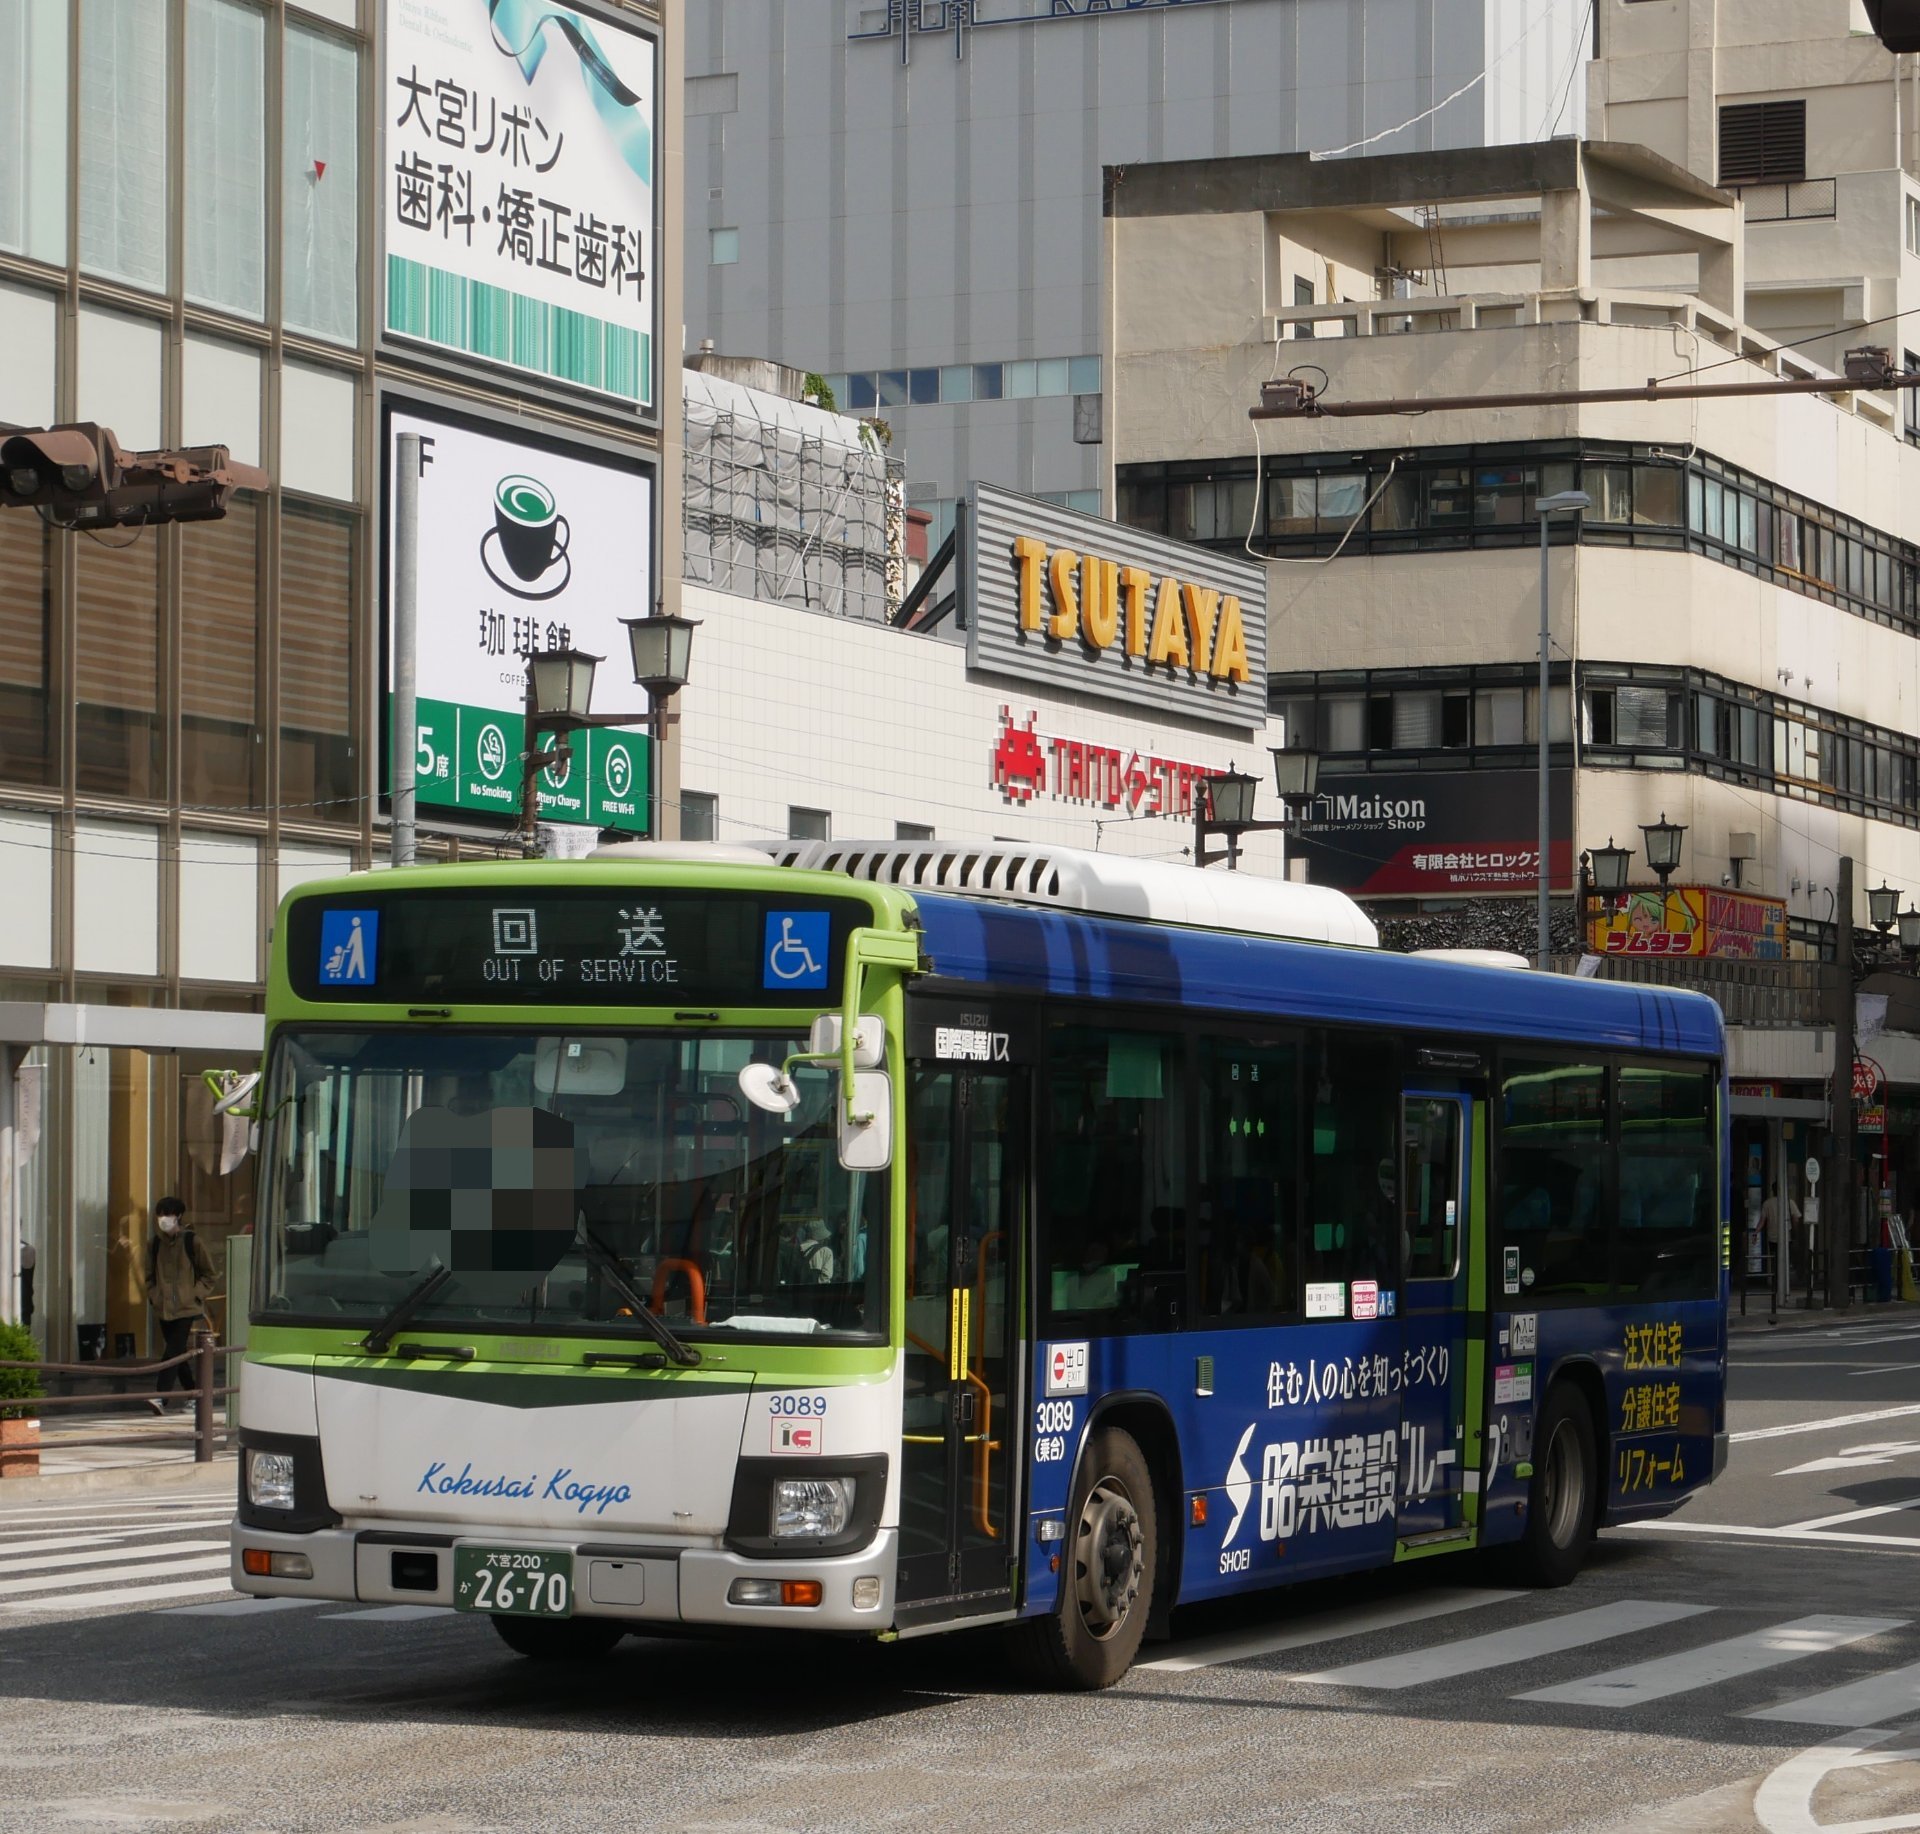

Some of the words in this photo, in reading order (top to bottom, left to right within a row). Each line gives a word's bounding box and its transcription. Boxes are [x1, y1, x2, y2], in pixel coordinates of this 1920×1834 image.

[396, 64, 564, 173] 大宮リボン
[394, 149, 646, 303] 歯科・矯正歯科
[1013, 536, 1250, 683] TSUTAYA
[499, 672, 531, 687] COFFE
[470, 783, 482, 796] No
[482, 785, 512, 802] Smoking
[536, 791, 557, 808] attery
[557, 794, 581, 810] Charge
[602, 800, 618, 813] FREE
[1336, 794, 1426, 820] Maison
[1387, 818, 1426, 832] Shop
[1606, 931, 1693, 954] ラムタラ
[483, 958, 523, 982] OUT
[539, 959, 565, 982] OF
[580, 959, 679, 983] SERVICE
[959, 1013, 989, 1027] ISUZU
[1066, 1348, 1085, 1368] 出口
[1623, 1320, 1683, 1371] 注文住宅
[1067, 1370, 1082, 1382] EXIT
[769, 1395, 827, 1416] 3089
[1036, 1400, 1074, 1434] 3089
[1621, 1381, 1681, 1431] 分譲住宅
[1619, 1443, 1684, 1494] リフォーム
[417, 1462, 537, 1499] Kokusai
[542, 1468, 632, 1515] Kogyo
[1219, 1549, 1250, 1574] SHOEI
[474, 1569, 568, 1610] 26-70
